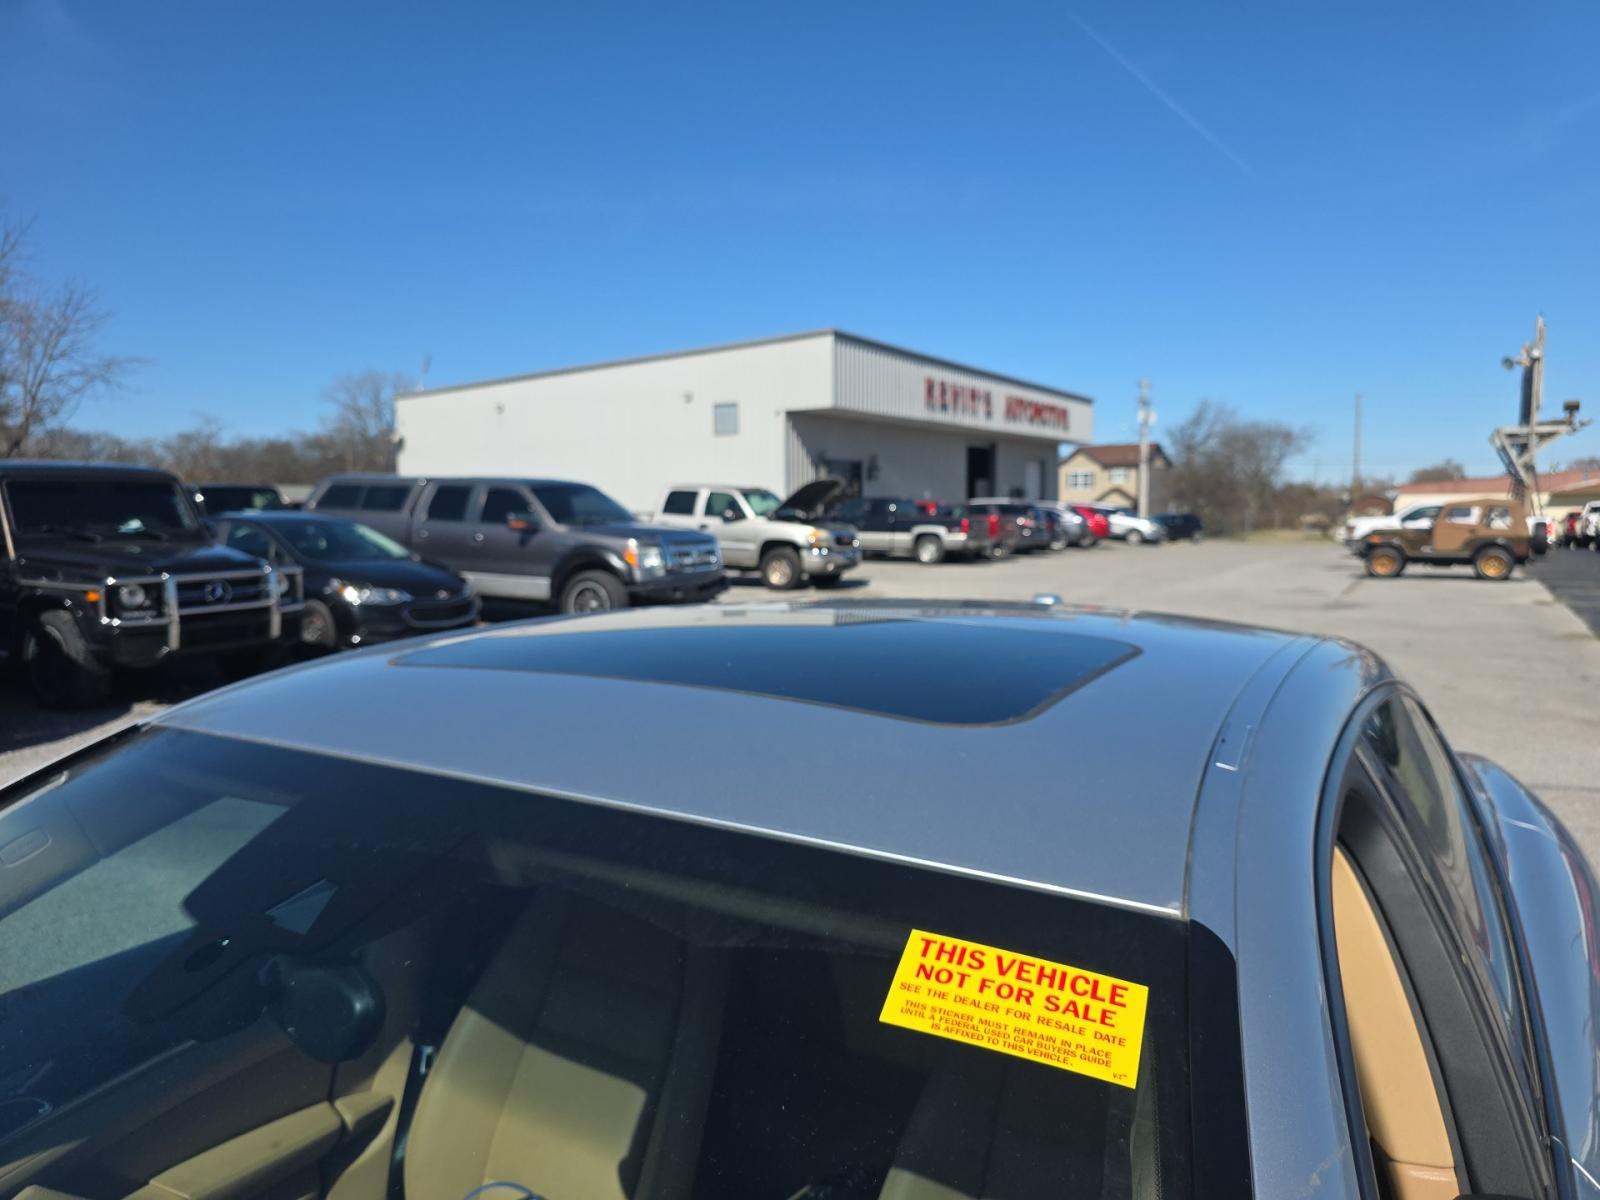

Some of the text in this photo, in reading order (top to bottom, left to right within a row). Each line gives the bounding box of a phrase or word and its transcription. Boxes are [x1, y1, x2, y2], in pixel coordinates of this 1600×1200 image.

[915, 963, 1117, 1028] NOT FOR SALE
[920, 937, 1129, 1008] THIS VEHICLE
[899, 982, 1127, 1047] SEE THE DEALER FOR RESALE DATE
[901, 1007, 925, 1018] UNTIL
[939, 1017, 979, 1032] FEDERAL
[984, 1028, 1010, 1040] USED
[1013, 1036, 1034, 1046] CAR
[1036, 1041, 1077, 1058] BUYERS
[1079, 1053, 1112, 1068] GUIDE
[905, 1000, 1112, 1059] THIS STICKER MUST REMAIN IN PLACE
[944, 1026, 984, 1041] AFFIXED
[987, 1037, 999, 1045] TO
[1003, 1040, 1025, 1052] THIS
[1027, 1048, 1073, 1066] VEHICLE.
